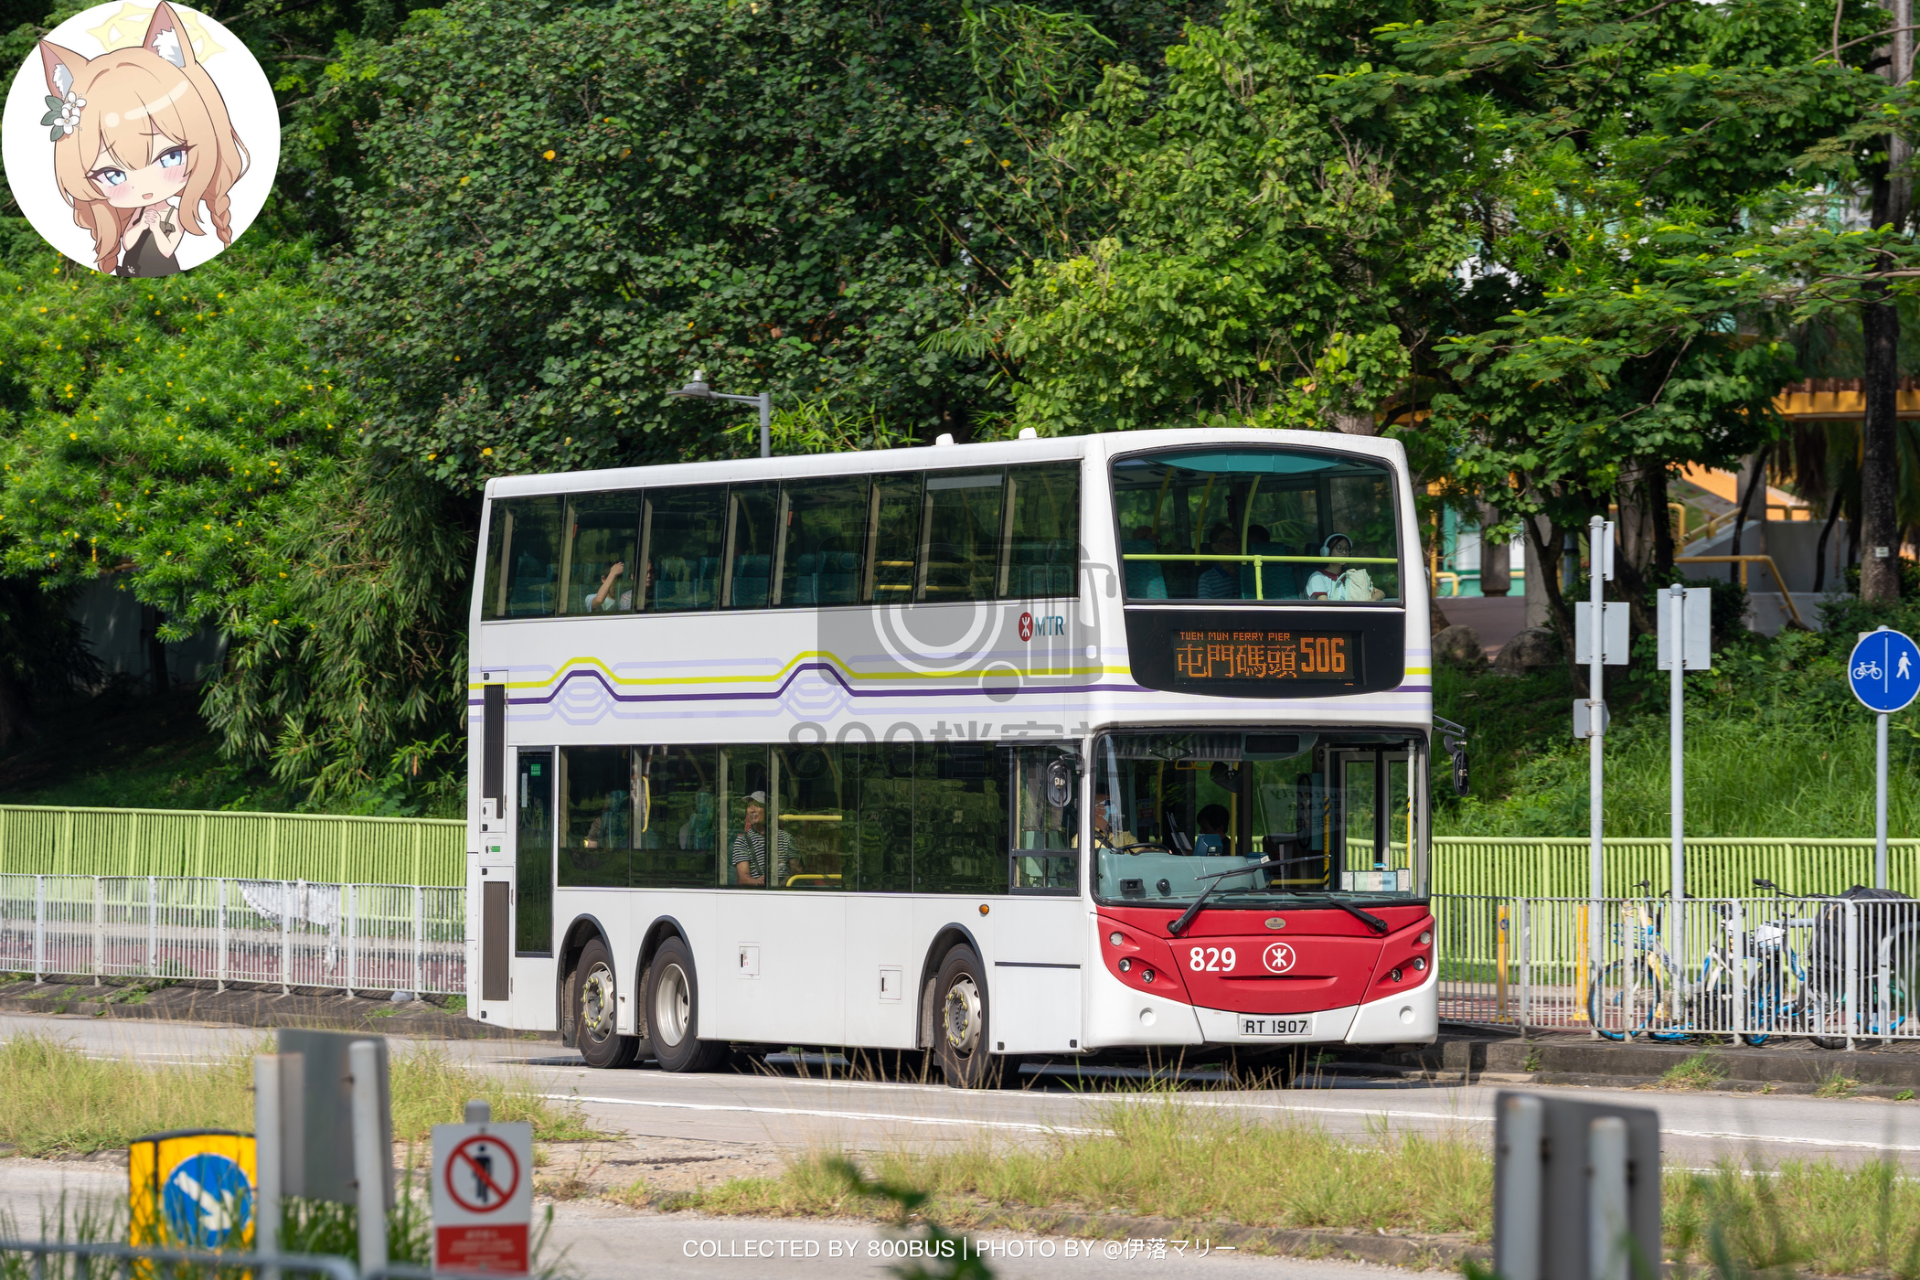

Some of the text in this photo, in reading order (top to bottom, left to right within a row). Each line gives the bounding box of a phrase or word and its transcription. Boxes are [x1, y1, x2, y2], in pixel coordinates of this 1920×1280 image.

[1035, 616, 1065, 636] MTR
[1180, 632, 1290, 641] TUEN MUN FERRY PIER
[1176, 644, 1298, 678] 屯門碼頭
[1300, 637, 1346, 673] 506
[1189, 946, 1236, 972] 829
[1245, 1020, 1307, 1033] RT 1907
